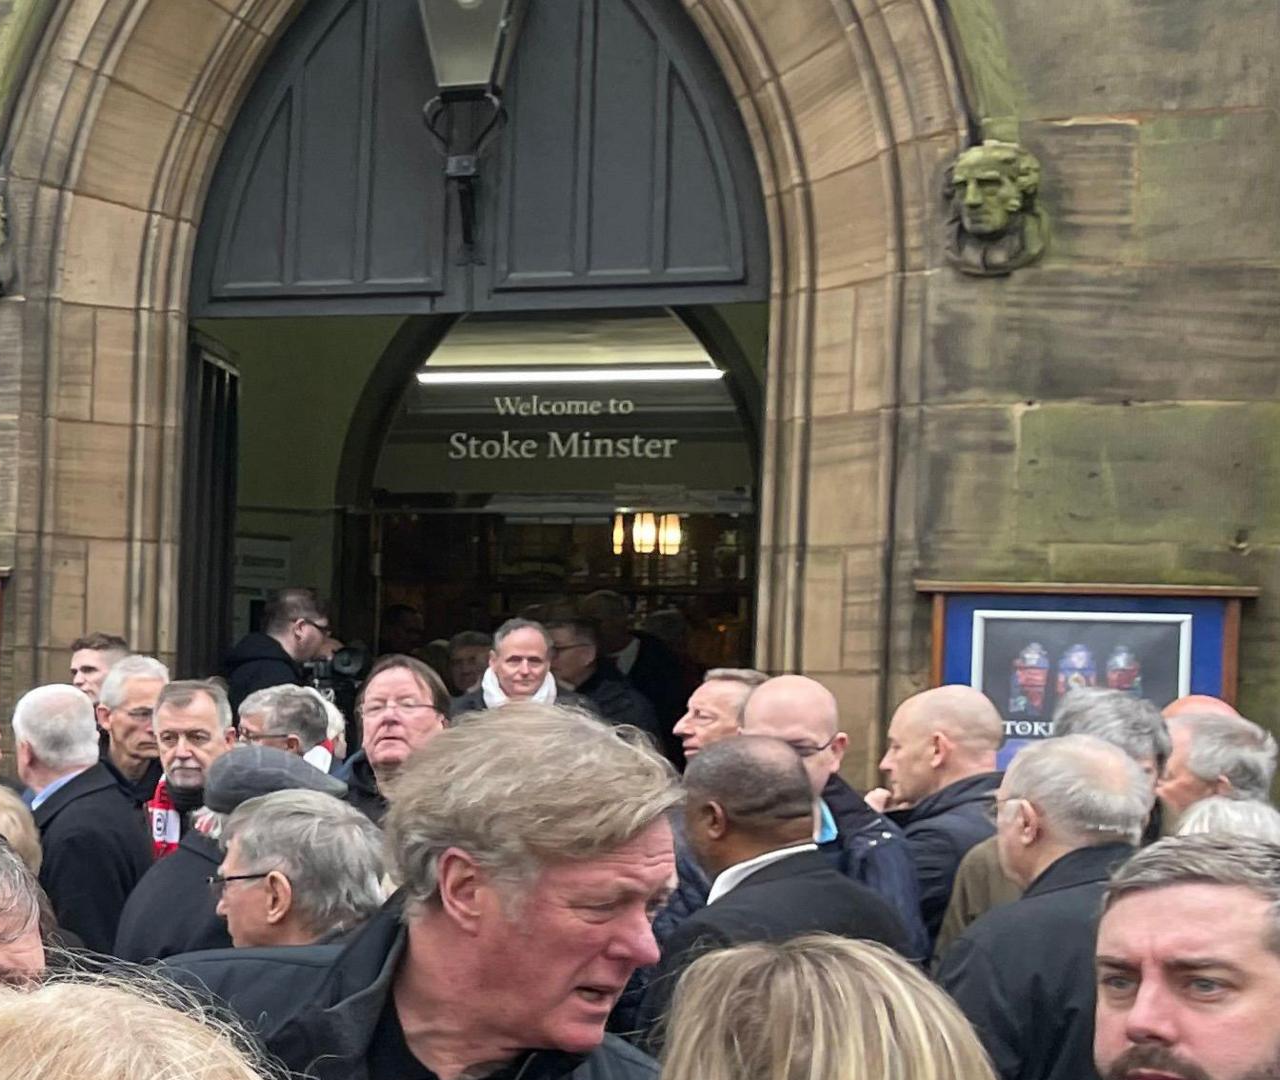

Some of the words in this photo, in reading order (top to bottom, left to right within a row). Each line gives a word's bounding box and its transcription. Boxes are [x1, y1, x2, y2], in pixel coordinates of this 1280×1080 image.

[494, 395, 602, 416] Welcome
[608, 397, 634, 416] to
[448, 430, 538, 460] Stoke
[547, 430, 678, 459] Minster
[1001, 719, 1055, 737] TOK
